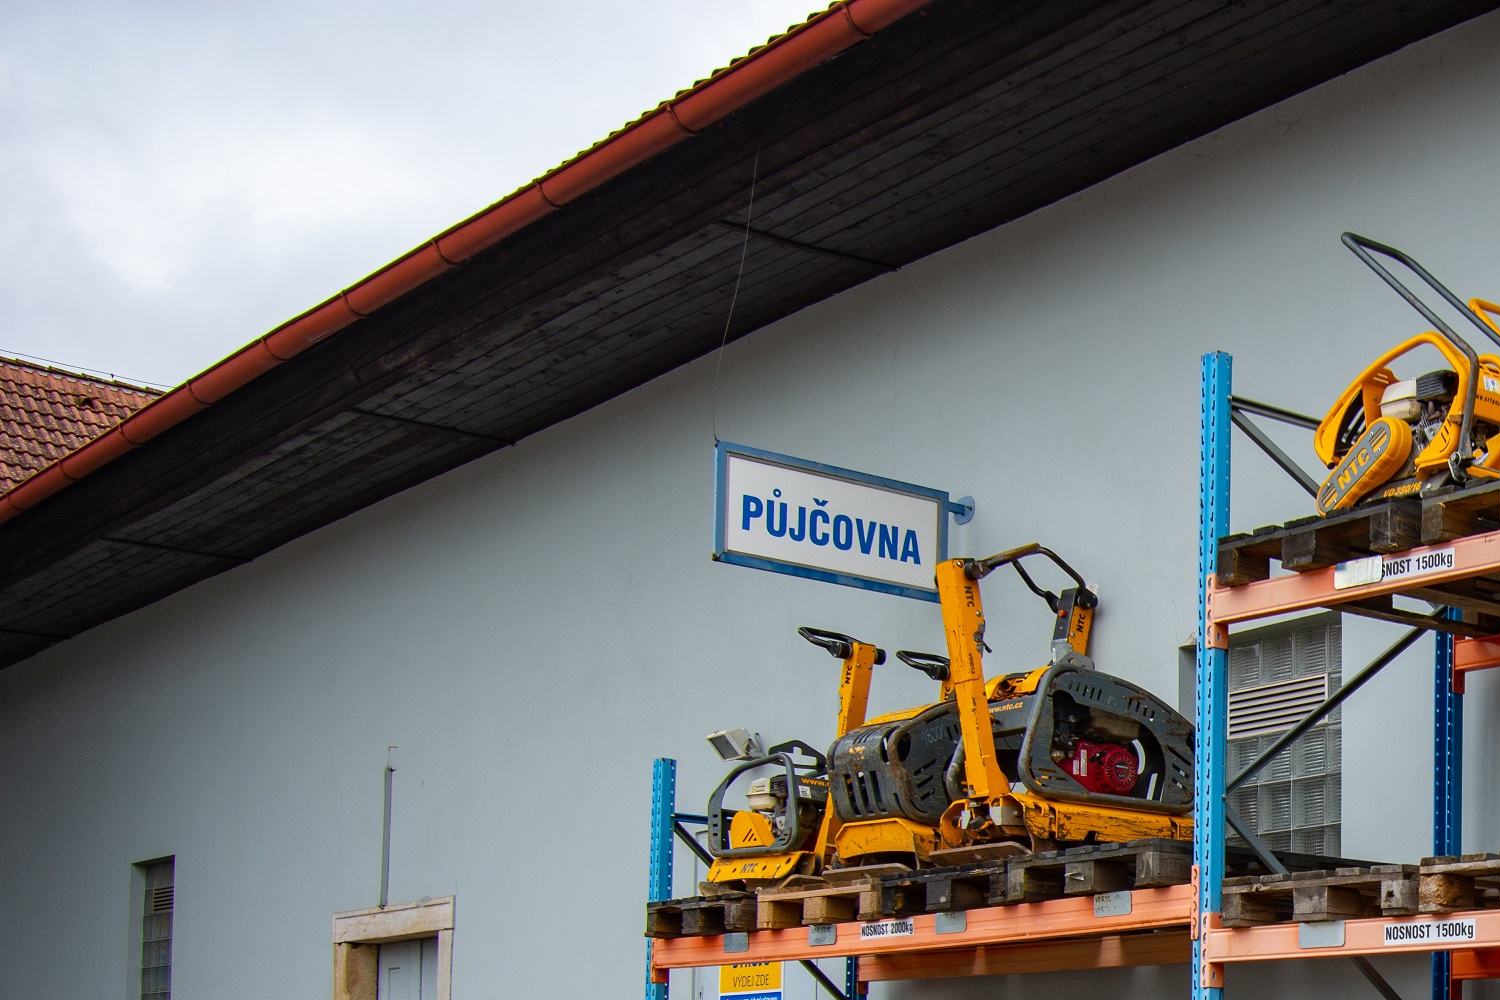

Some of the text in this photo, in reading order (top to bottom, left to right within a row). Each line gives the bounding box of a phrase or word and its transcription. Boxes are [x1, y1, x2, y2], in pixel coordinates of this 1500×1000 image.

[1336, 447, 1370, 490] NTC
[741, 488, 921, 565] PŮJČOVNA
[1416, 552, 1453, 571] 1500kg
[964, 585, 975, 608] NTC
[1076, 613, 1086, 633] NTC
[845, 664, 853, 685] NTC
[740, 862, 759, 874] NTC
[861, 922, 913, 938] NOSNOST 2000kg
[1385, 922, 1474, 940] NOSNOST 1500kg
[732, 973, 769, 988] VÝDEJ ZDE
